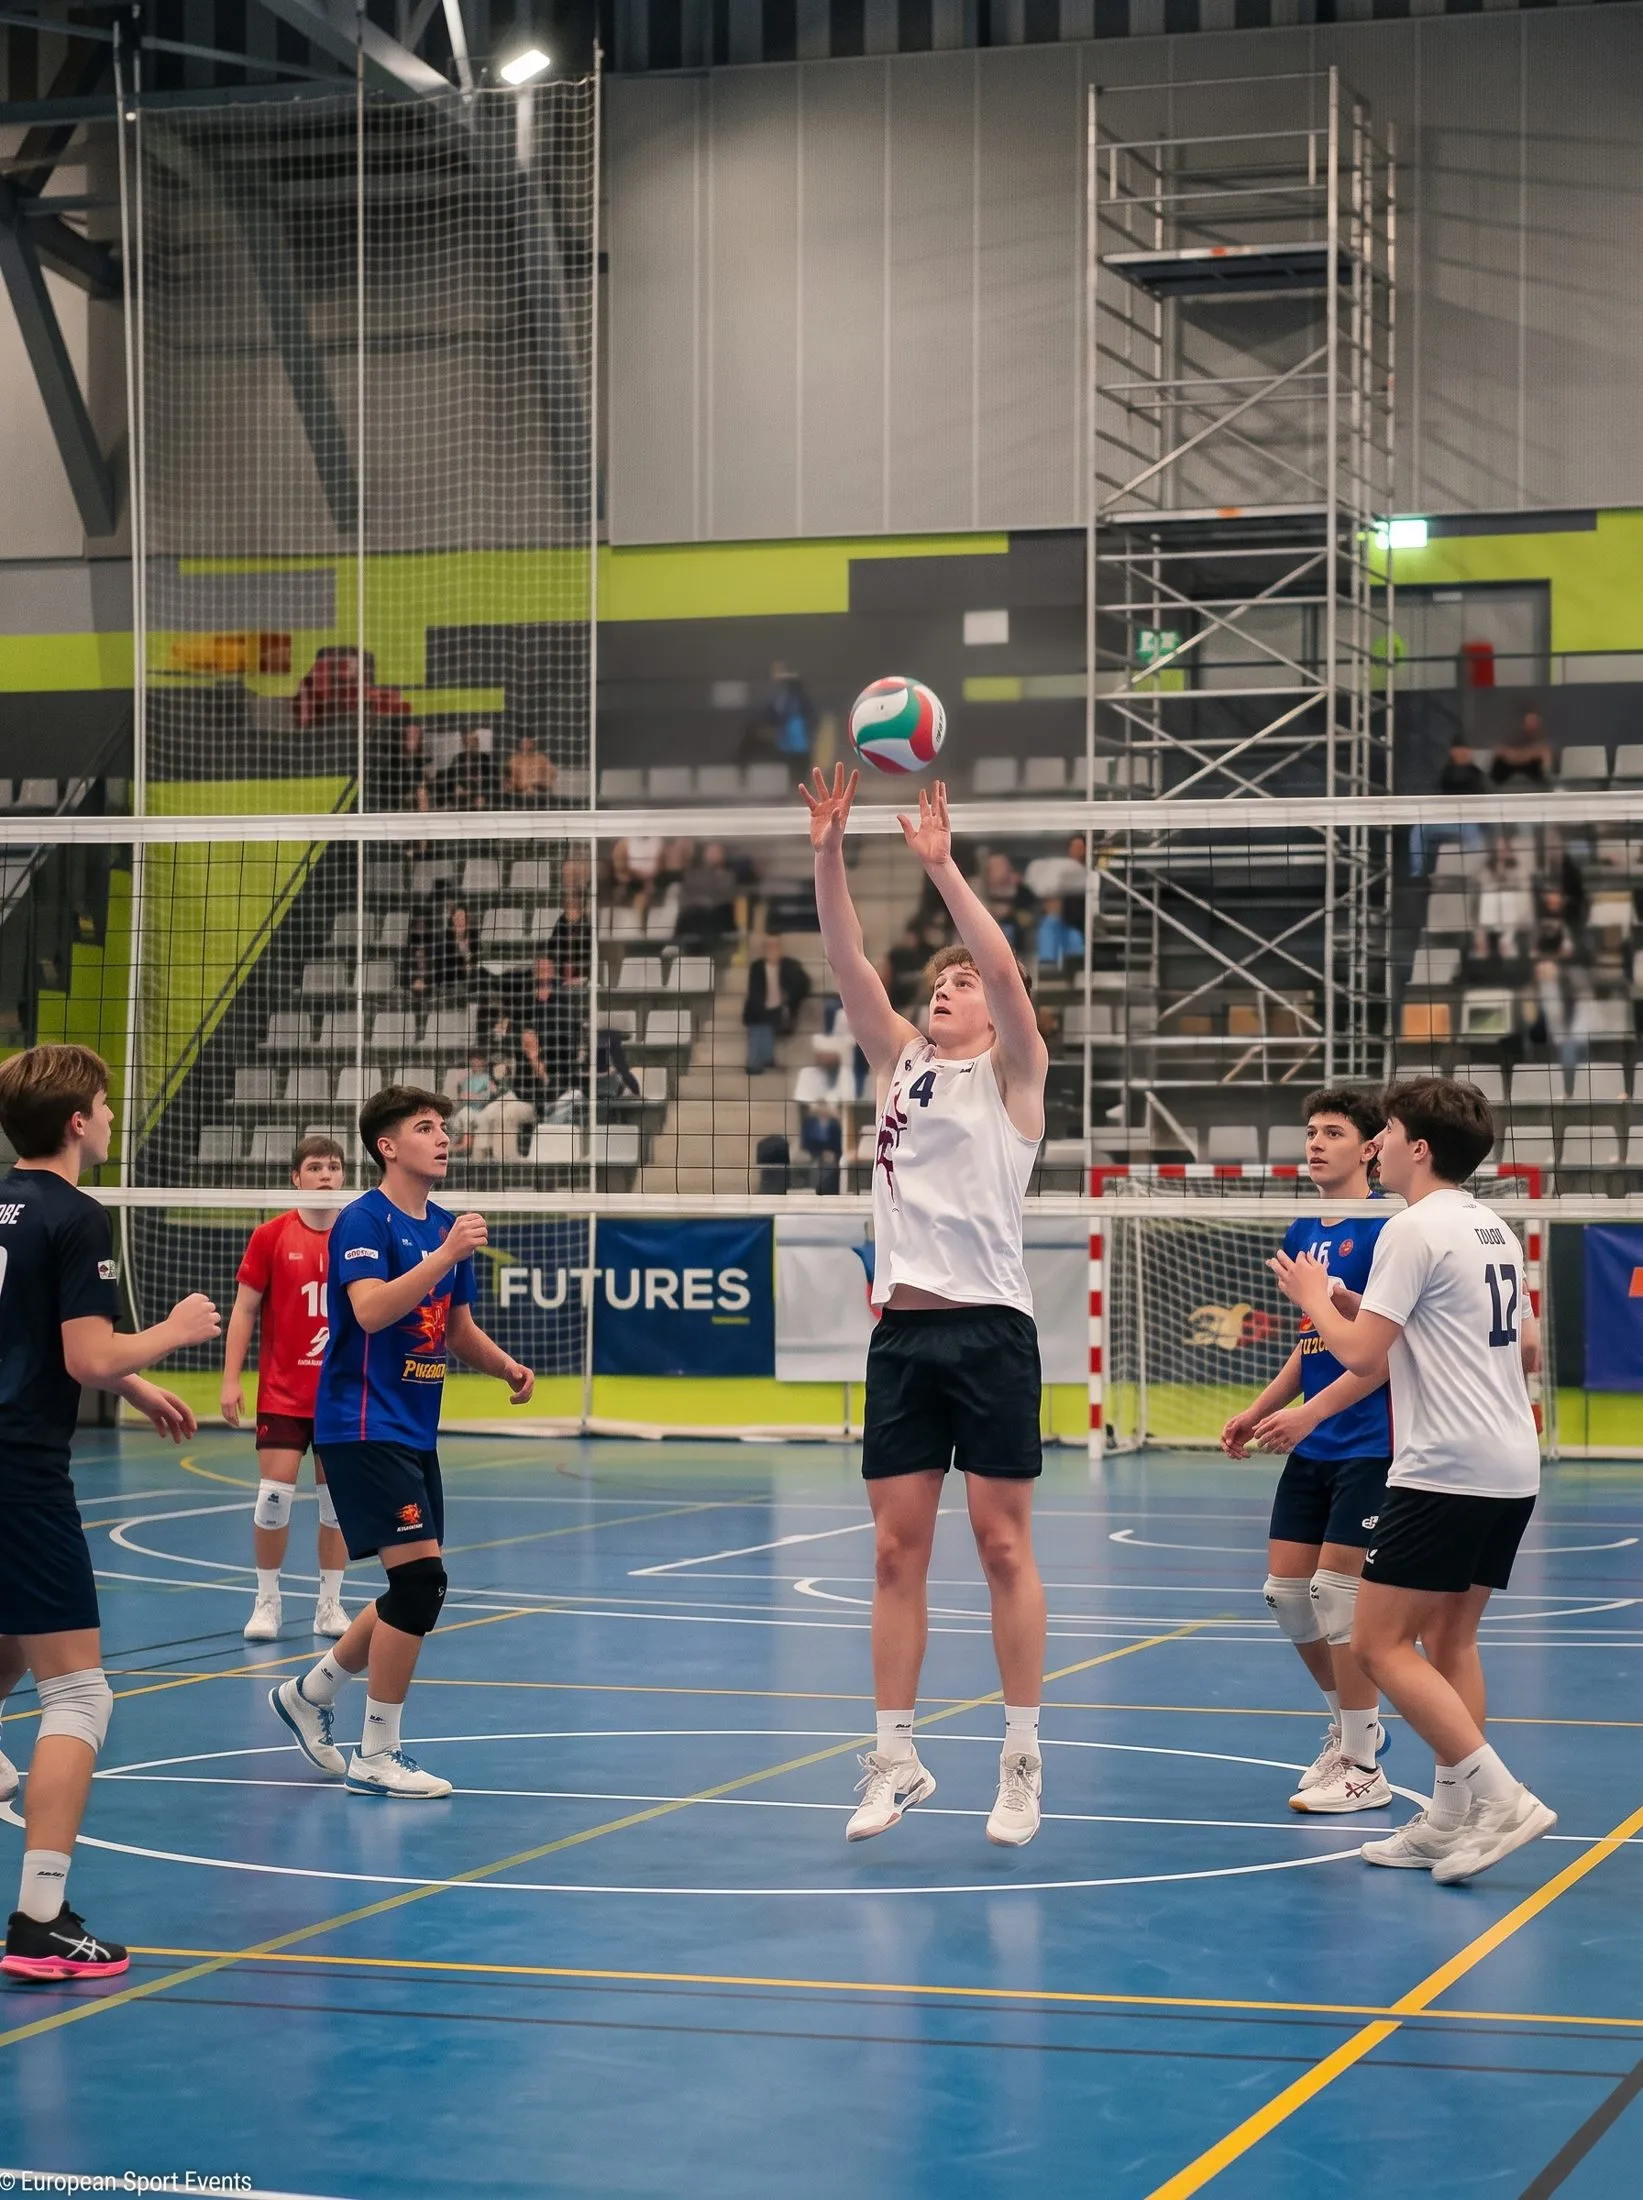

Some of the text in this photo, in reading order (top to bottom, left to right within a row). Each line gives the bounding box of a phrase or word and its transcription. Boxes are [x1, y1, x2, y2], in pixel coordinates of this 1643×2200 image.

[909, 1071, 936, 1108] 4
[500, 1268, 751, 1311] FUTURES
[1485, 1264, 1517, 1348] 12
